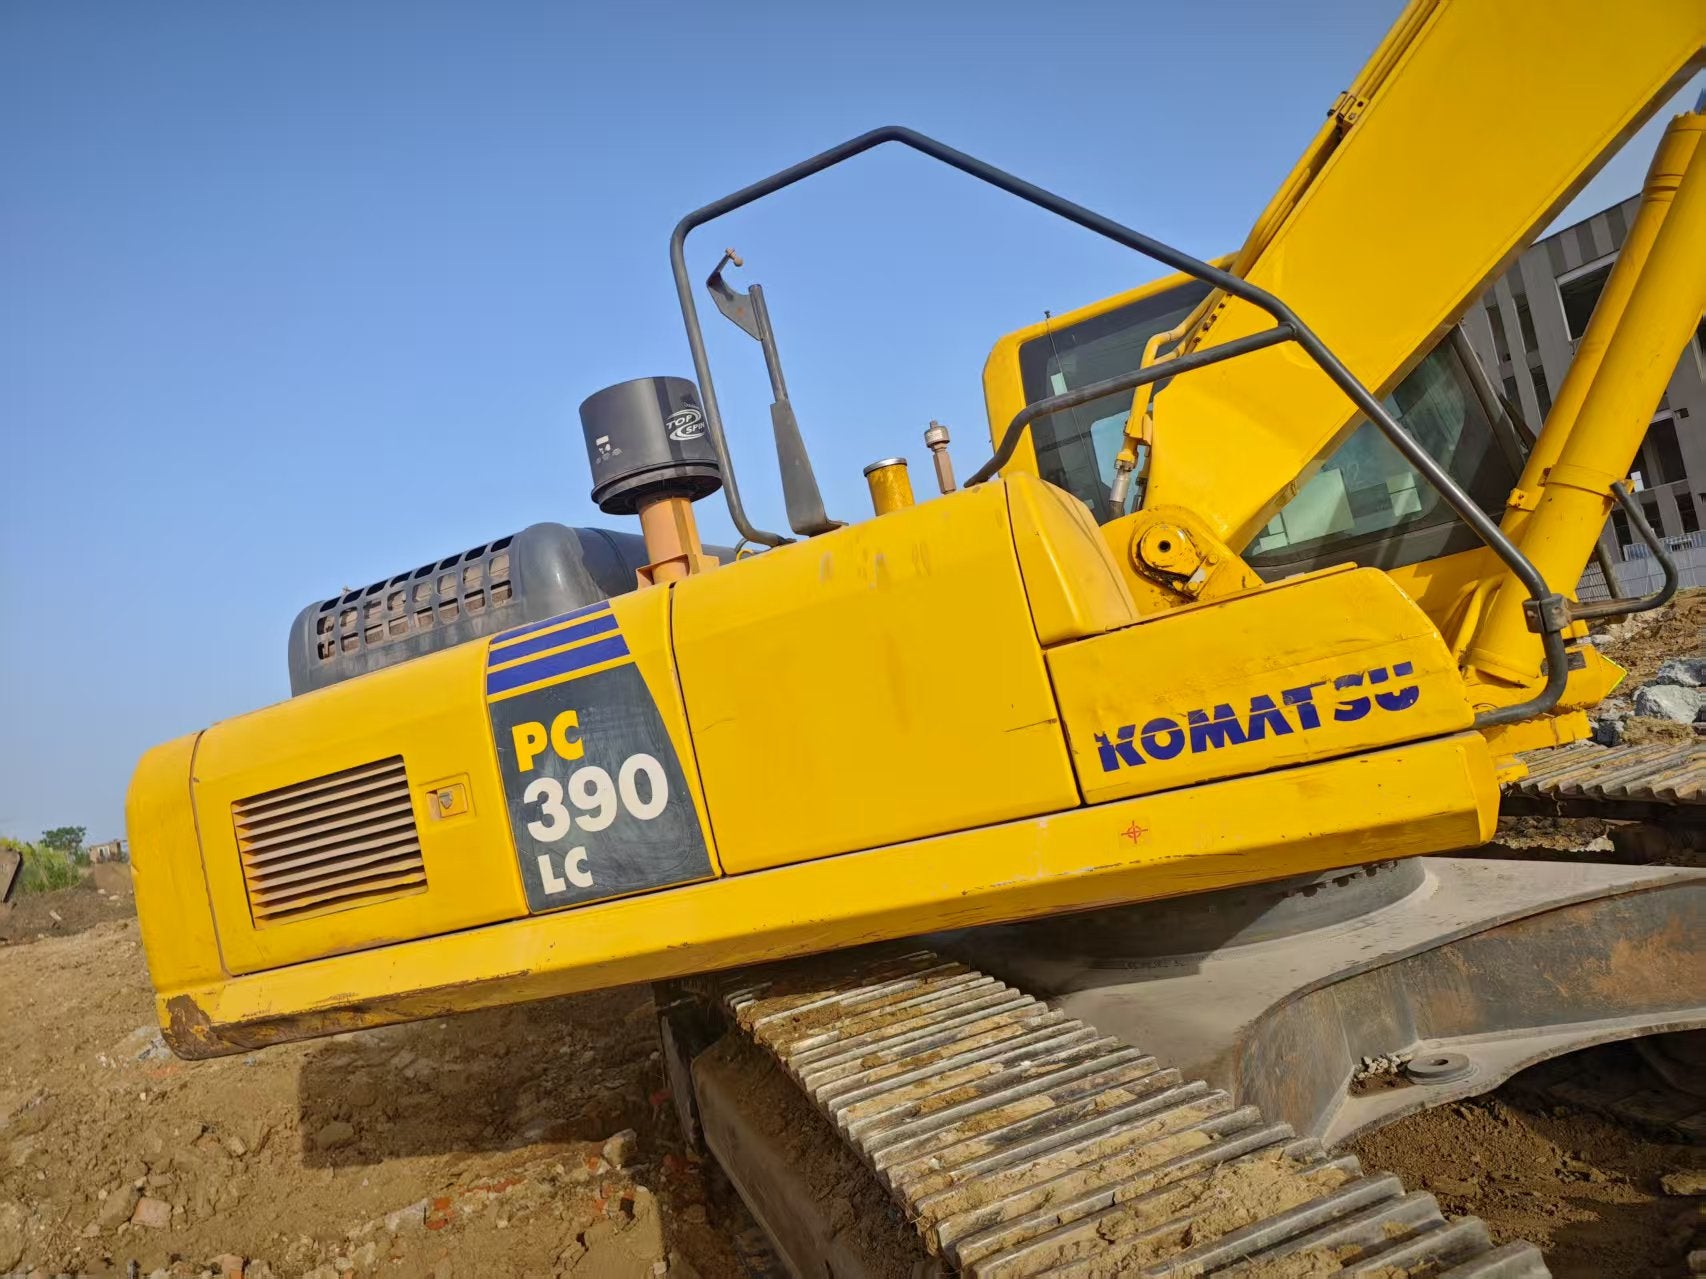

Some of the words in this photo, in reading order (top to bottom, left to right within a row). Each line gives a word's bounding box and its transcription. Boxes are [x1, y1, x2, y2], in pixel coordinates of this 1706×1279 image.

[666, 414, 693, 430] TOP
[685, 421, 705, 435] SPIN
[511, 710, 585, 773] PC
[1094, 661, 1420, 772] KOMATSU
[523, 753, 669, 842] 390
[537, 846, 594, 895] LC
